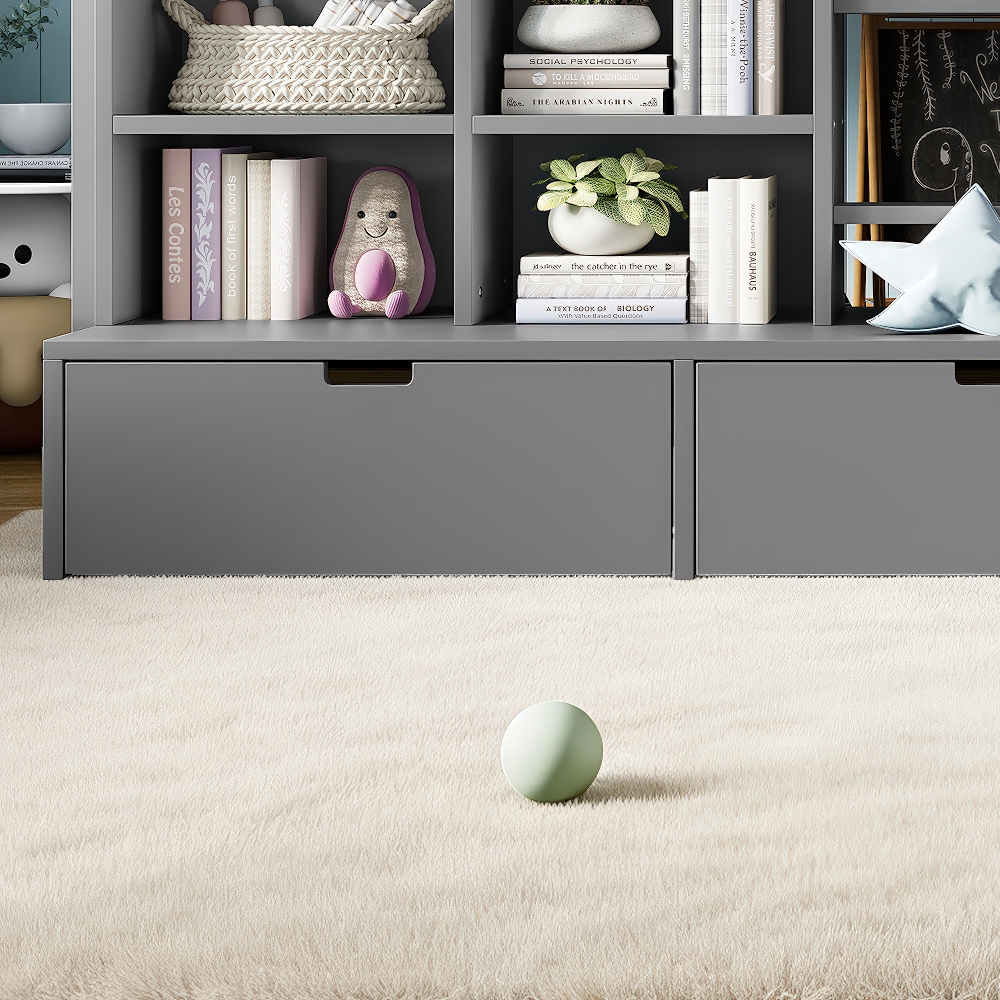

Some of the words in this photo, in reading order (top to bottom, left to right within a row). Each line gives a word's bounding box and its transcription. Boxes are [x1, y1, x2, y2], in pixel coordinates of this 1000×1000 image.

[765, 29, 775, 62] TWIST
[551, 73, 562, 81] TO
[563, 73, 578, 81] KILL
[579, 73, 586, 81] A
[532, 98, 550, 106] THE
[552, 98, 594, 106] ARABIAN
[597, 98, 634, 106] NIGHTS
[168, 186, 185, 217] Les
[227, 175, 237, 216] words
[227, 220, 237, 246] first
[168, 222, 185, 284] Contes
[227, 247, 237, 262] of
[571, 262, 585, 270] the
[586, 262, 617, 270] catcher
[619, 262, 627, 270] in
[629, 262, 643, 270] the
[644, 263, 658, 272] rye
[227, 265, 237, 297] book
[748, 251, 757, 291] BAUHAUS
